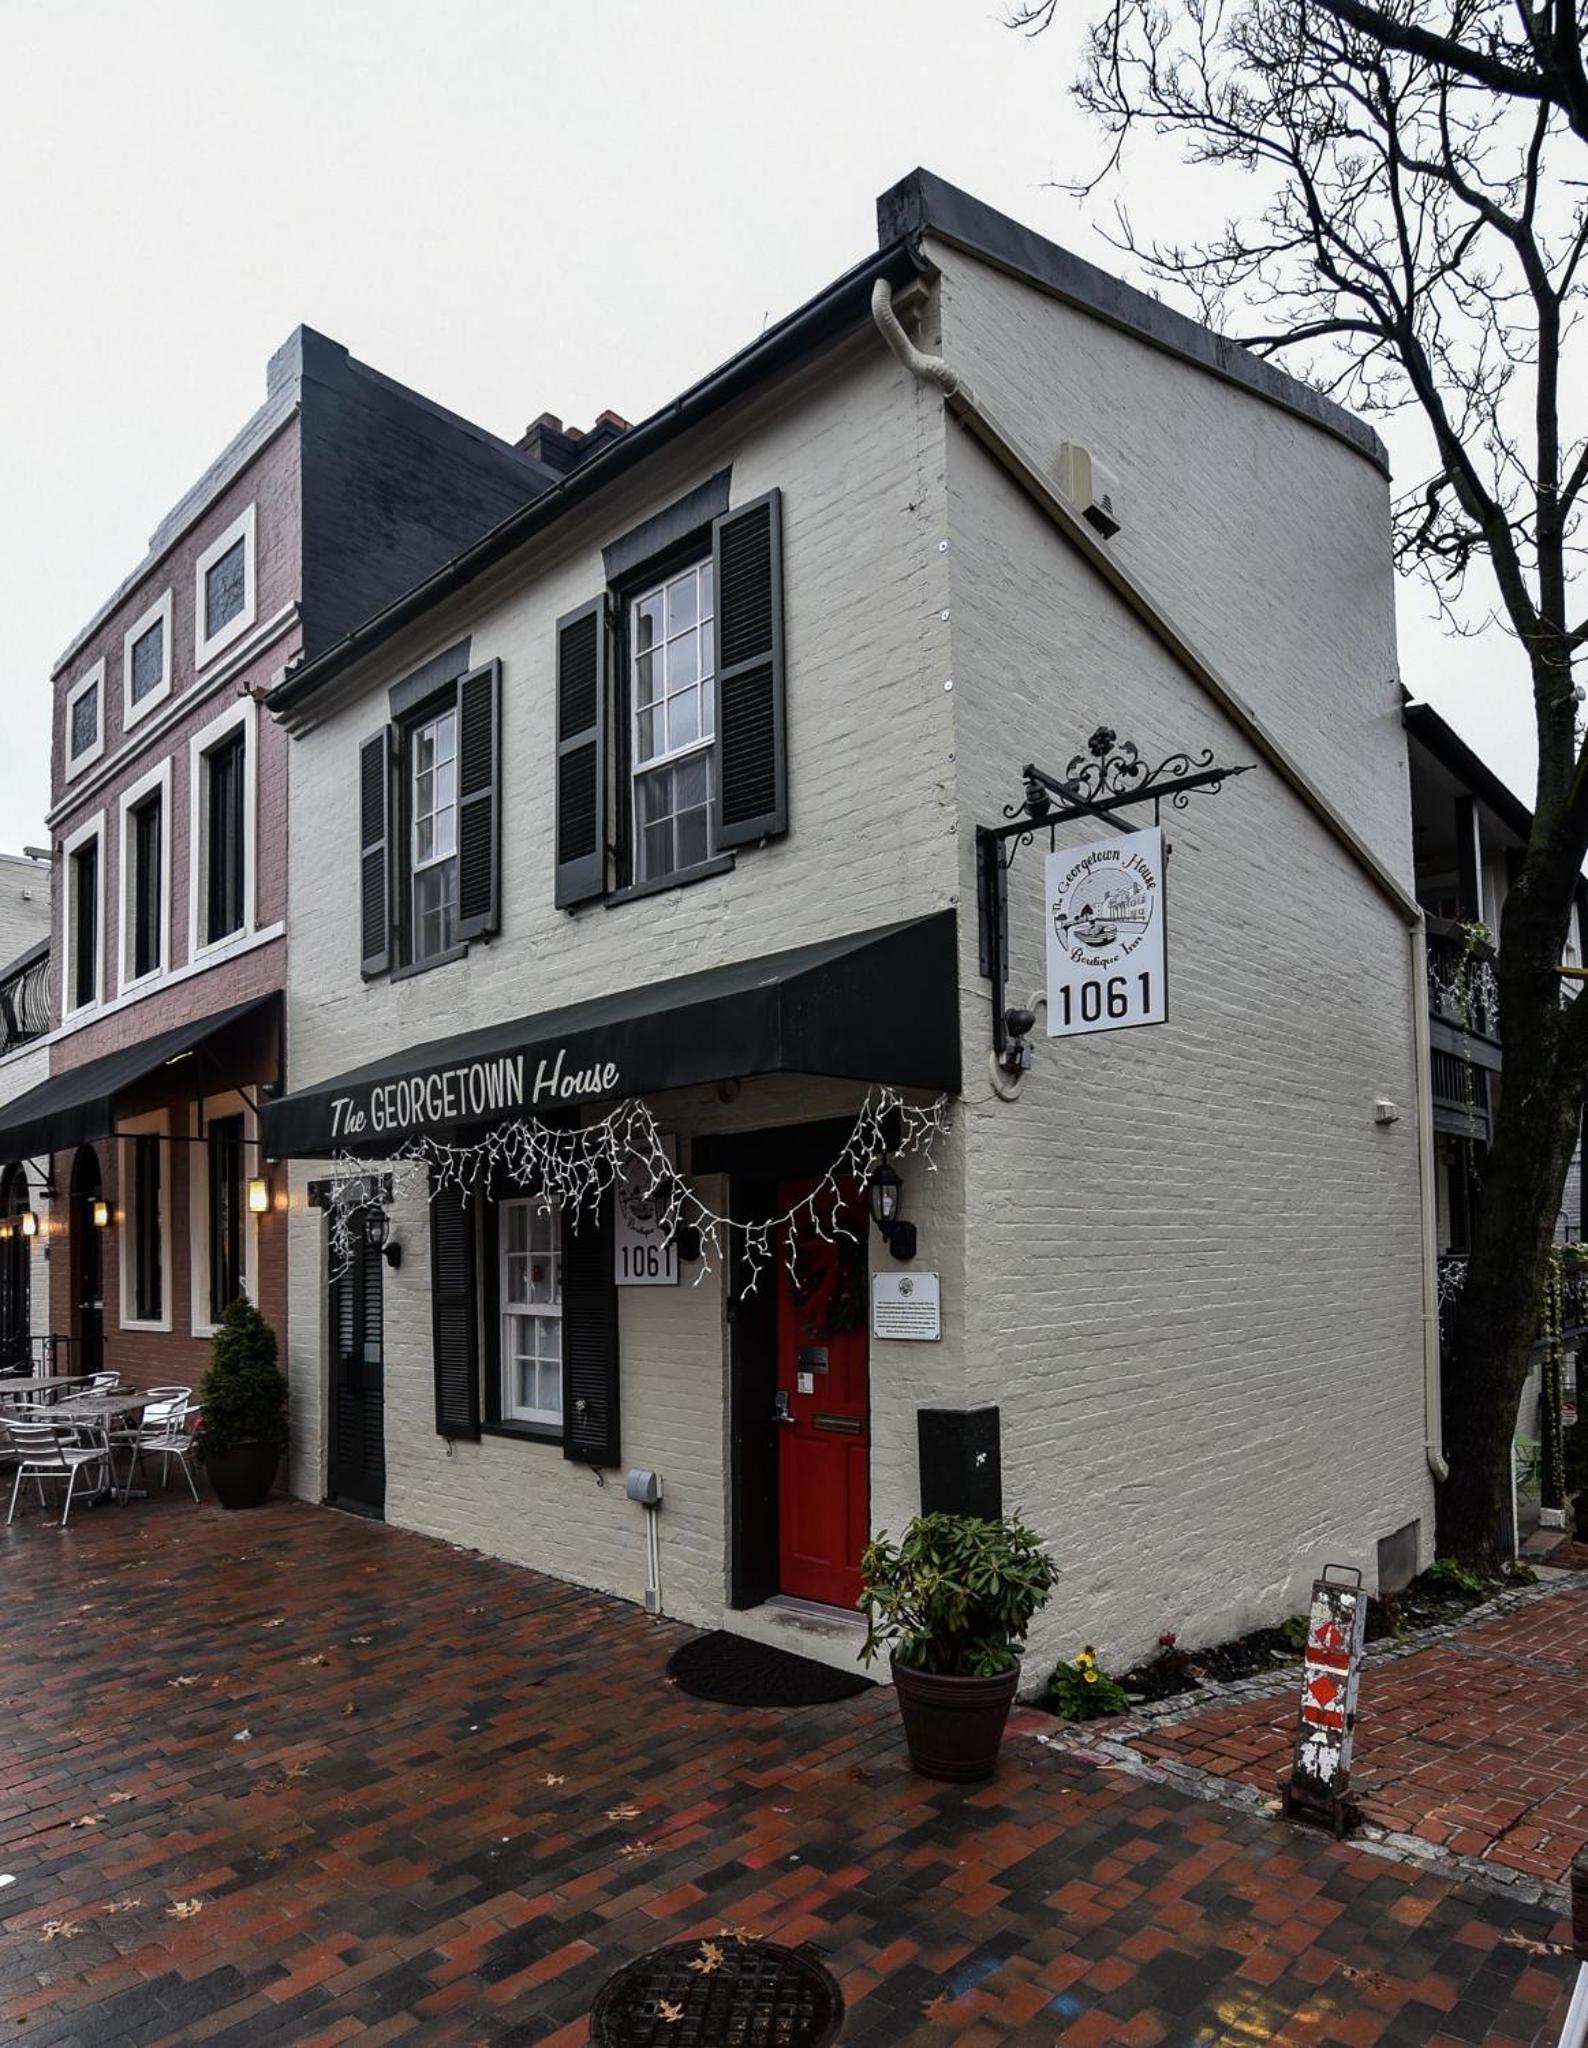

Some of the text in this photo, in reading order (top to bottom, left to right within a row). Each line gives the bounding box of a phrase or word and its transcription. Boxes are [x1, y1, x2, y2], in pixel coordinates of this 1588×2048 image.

[1058, 850, 1156, 893] Georgetown House
[1071, 937, 1142, 970] Boutique Inn
[1060, 972, 1150, 1025] 1061
[331, 1049, 619, 1137] The GEORGETOWN House
[622, 1245, 670, 1277] 1061
